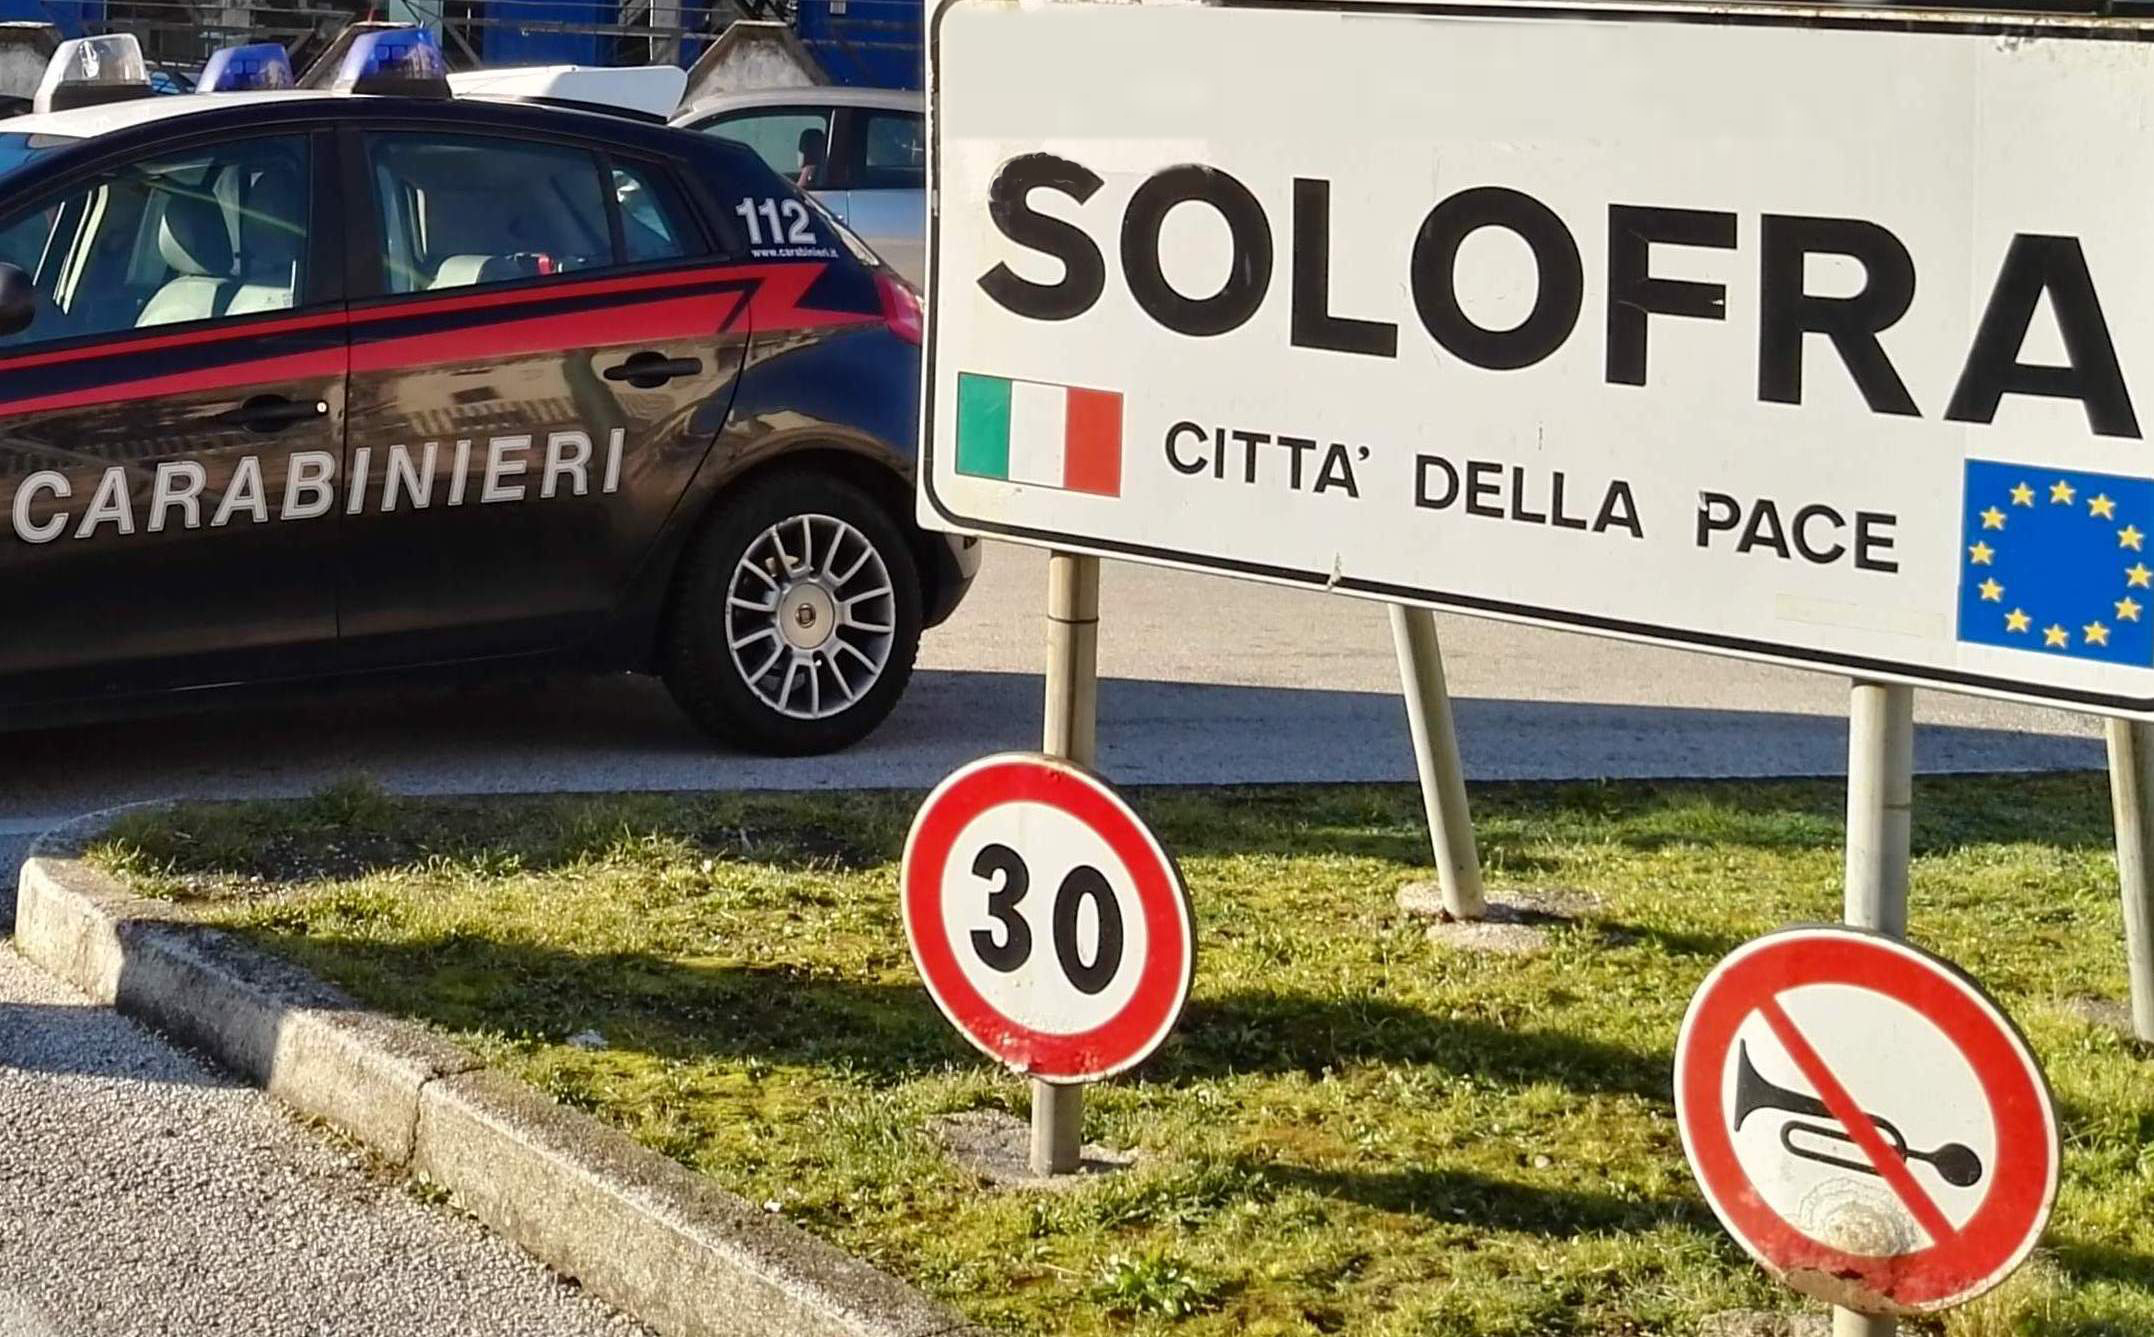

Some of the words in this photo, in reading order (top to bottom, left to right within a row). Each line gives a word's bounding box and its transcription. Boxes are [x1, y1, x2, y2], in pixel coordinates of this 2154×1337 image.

[736, 198, 816, 244] 112
[751, 246, 839, 258] www.carabinieri.it
[978, 152, 2143, 440] SOLOFRA
[12, 427, 625, 542] CARABINIERI
[1415, 454, 1644, 539] DELLA
[1697, 490, 1899, 574] PACE
[970, 843, 1124, 995] 30
